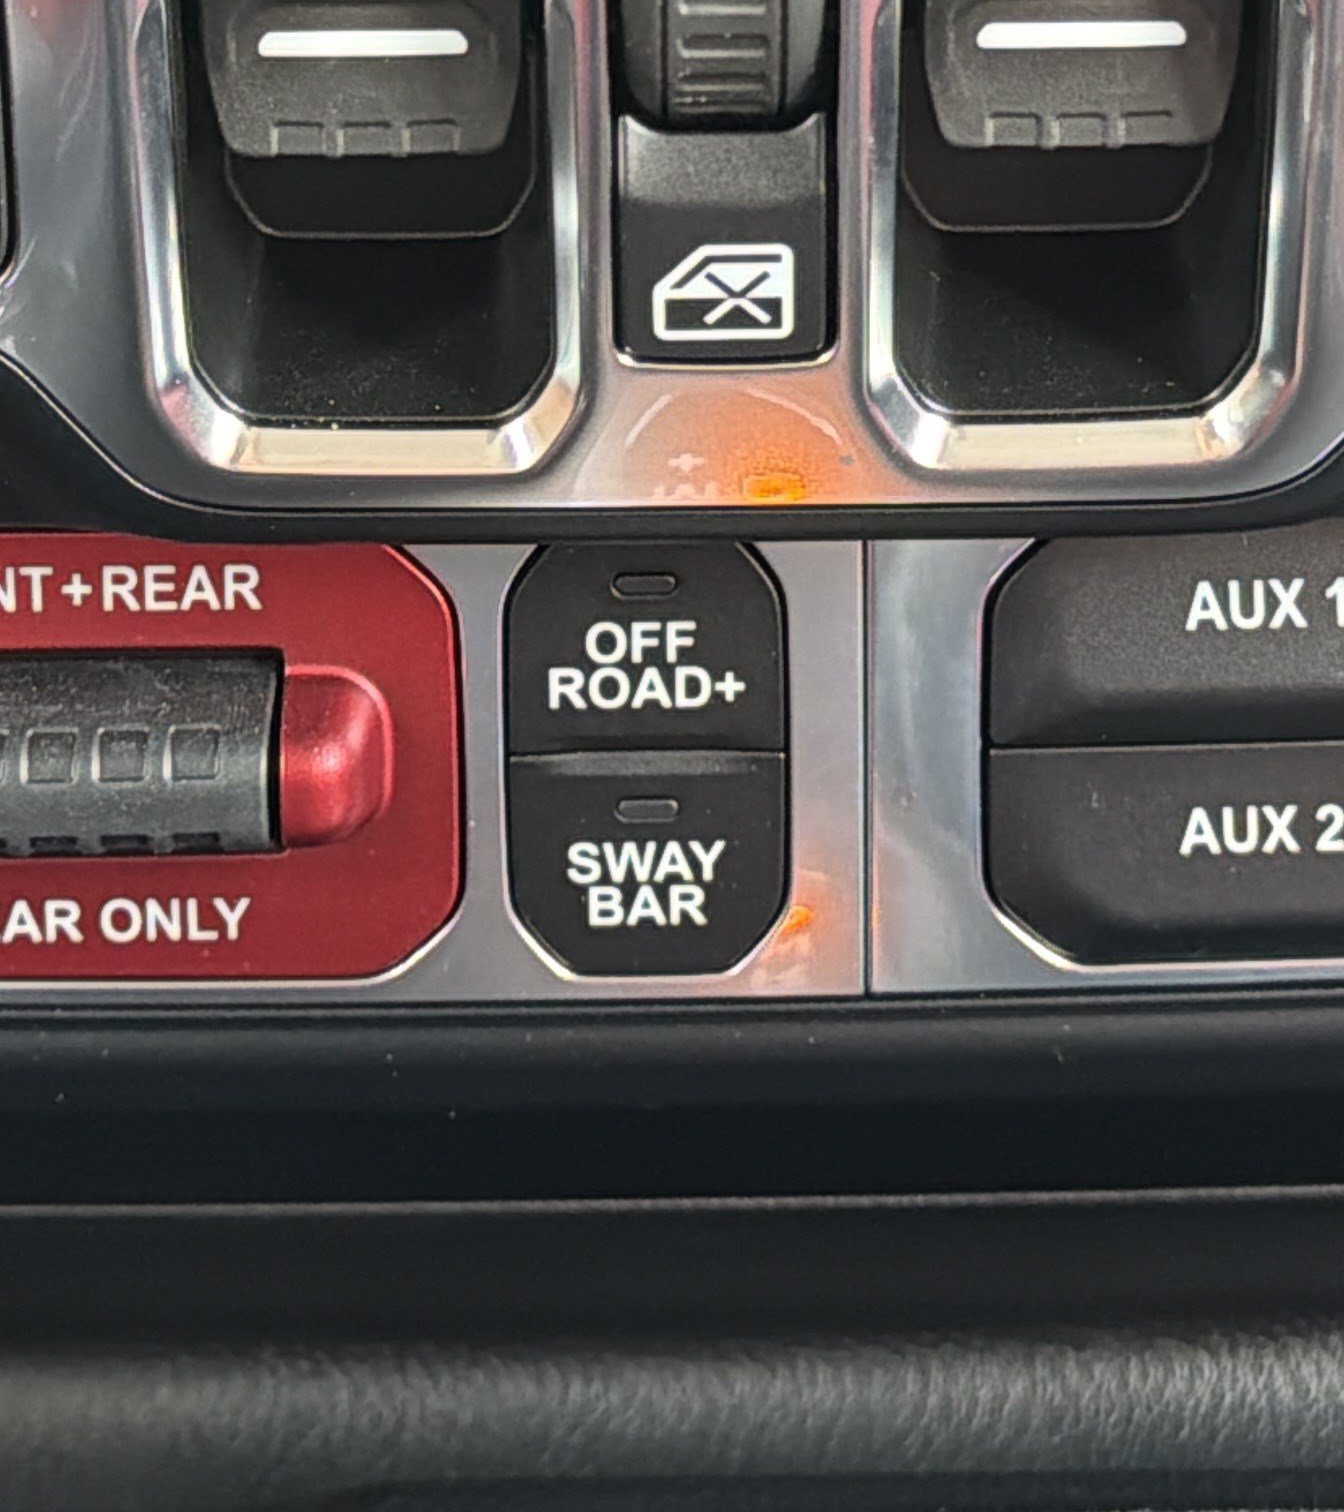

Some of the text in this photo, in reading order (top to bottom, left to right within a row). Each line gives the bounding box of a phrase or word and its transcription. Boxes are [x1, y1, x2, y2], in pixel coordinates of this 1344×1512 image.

[1185, 577, 1309, 632] AUX
[585, 620, 697, 664] OFF
[547, 665, 746, 710] ROAD+
[1178, 804, 1301, 856] AUX
[567, 839, 726, 884] SWAY
[100, 897, 251, 943] ONLY
[588, 884, 708, 927] BAR
